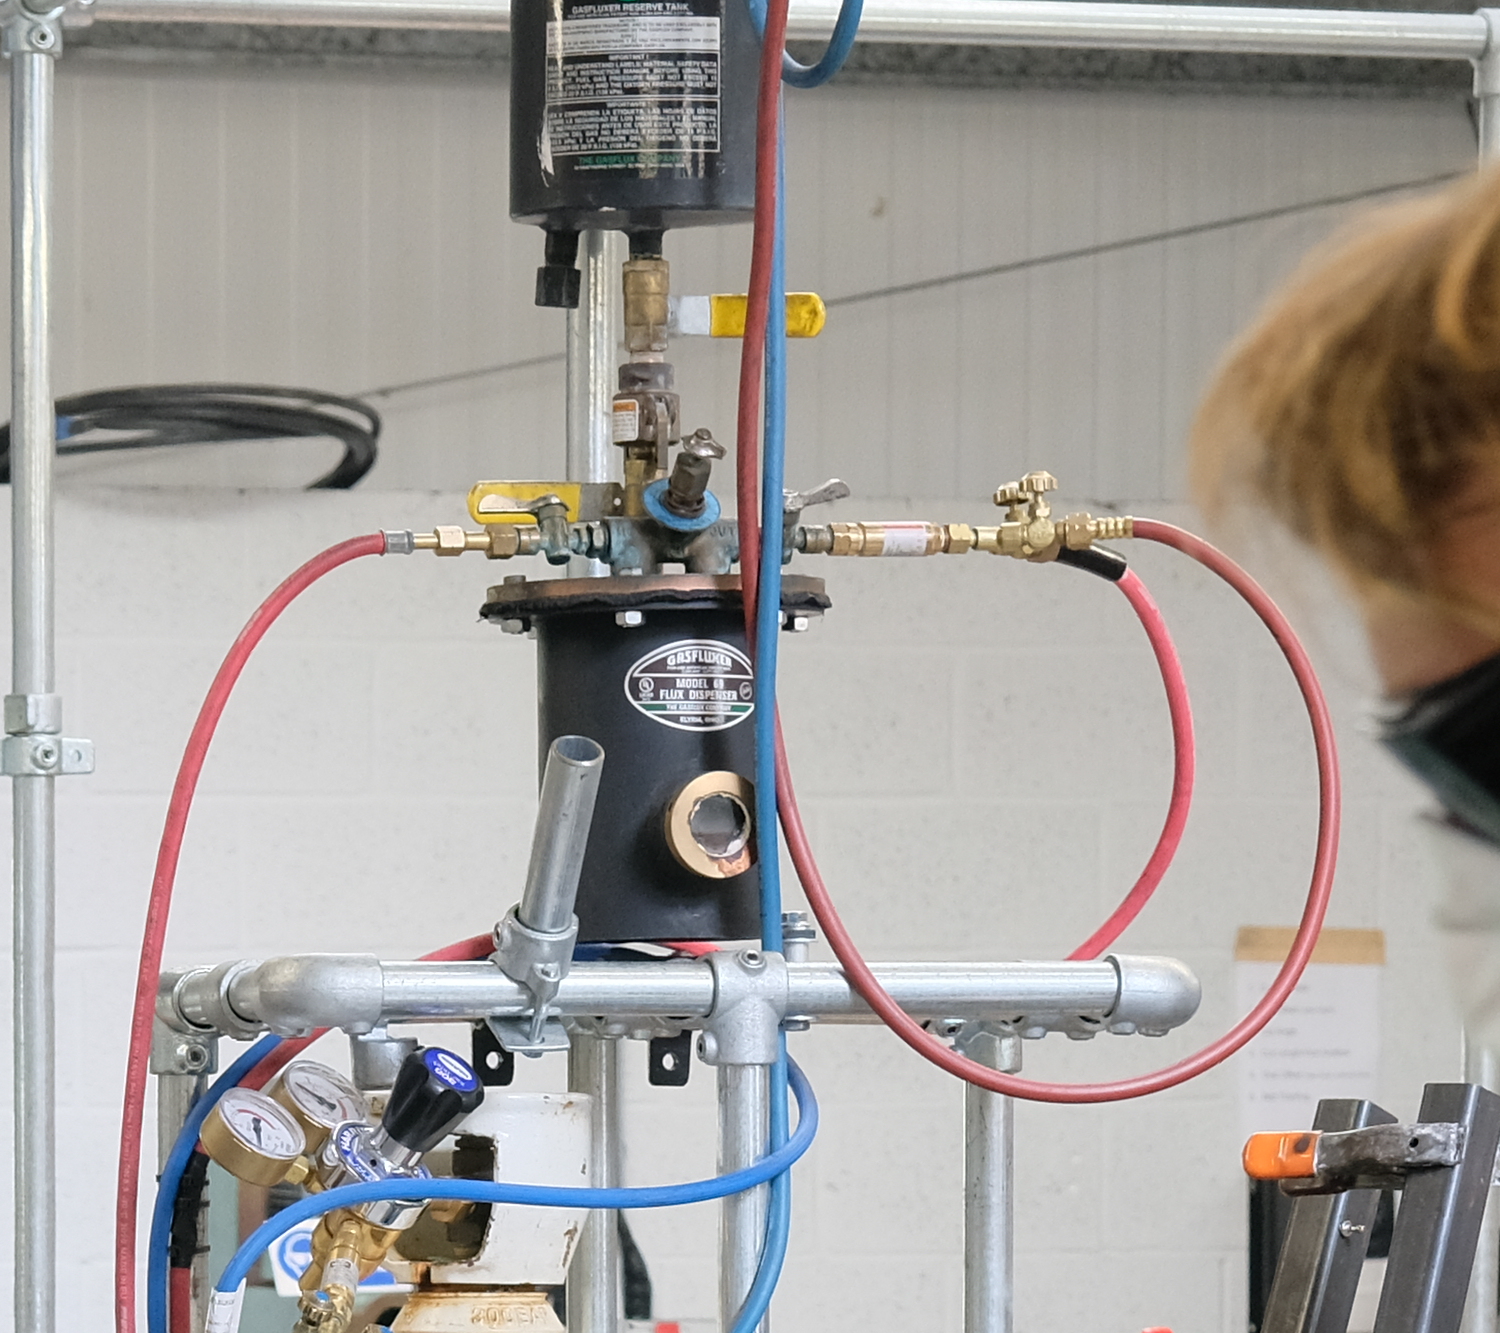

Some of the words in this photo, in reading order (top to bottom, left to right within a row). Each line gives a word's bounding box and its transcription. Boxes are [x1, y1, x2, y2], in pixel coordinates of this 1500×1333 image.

[622, 2, 664, 12] RESERVE
[665, 2, 689, 11] TANK
[666, 649, 732, 667] GASFLUXER
[675, 678, 709, 689] MODEL
[659, 689, 685, 700] FLUX
[688, 689, 738, 701] DISPENSER
